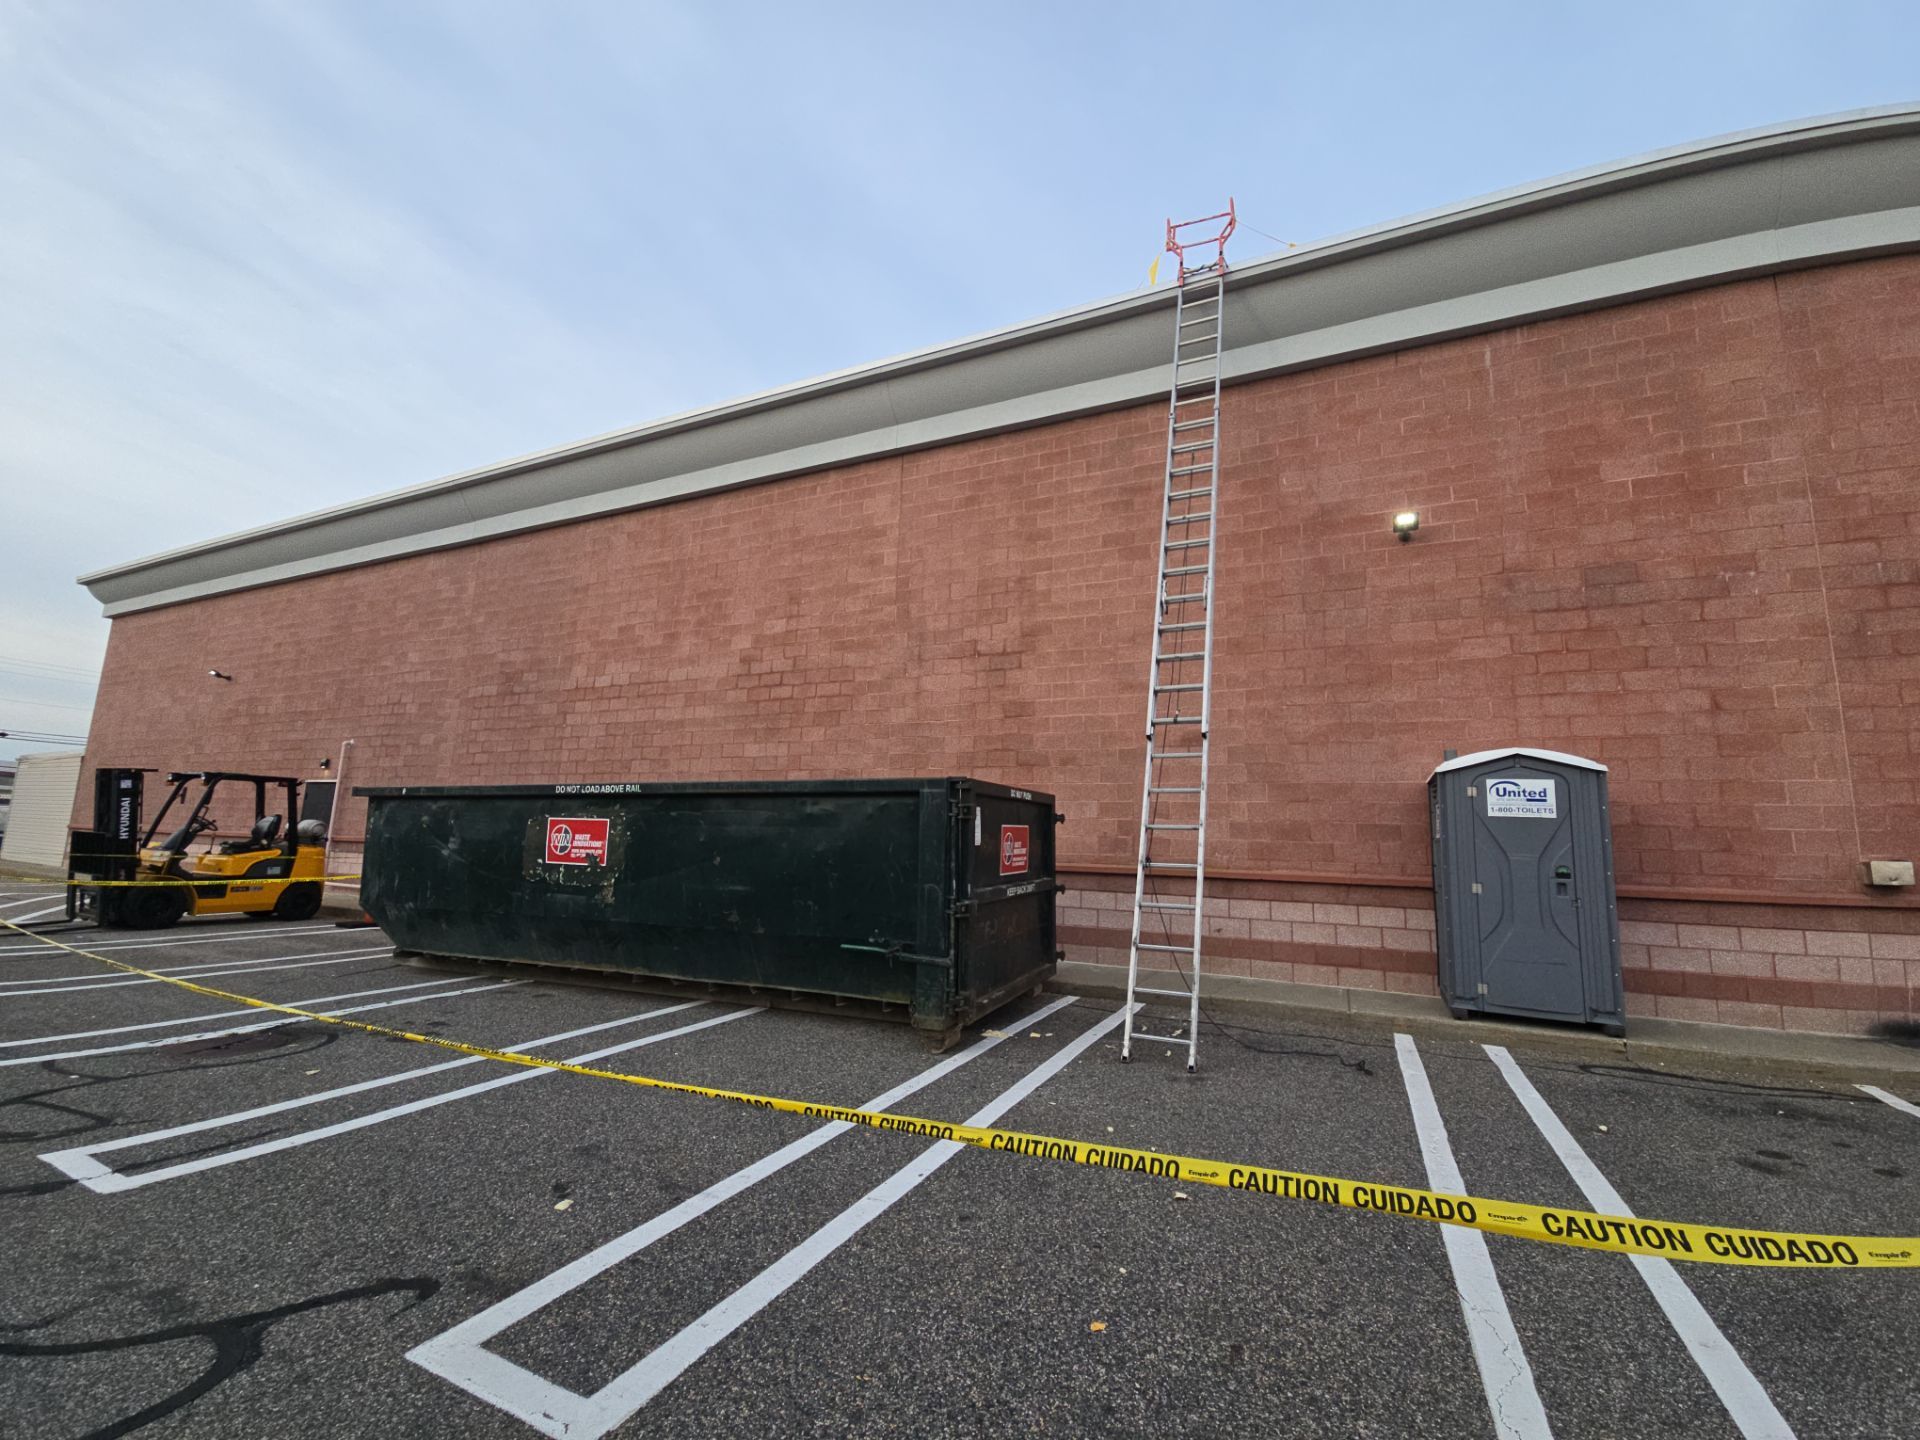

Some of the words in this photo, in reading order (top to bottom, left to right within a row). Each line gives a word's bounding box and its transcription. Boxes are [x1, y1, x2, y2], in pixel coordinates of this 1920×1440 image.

[555, 785, 566, 793] DO
[567, 785, 580, 794] NOT
[581, 785, 600, 794] LOAD
[600, 785, 625, 793] ABOVE
[625, 784, 642, 793] RAIL
[1496, 786, 1548, 798] United
[119, 797, 131, 839] HYUNDAI
[1490, 806, 1555, 815] 1-800-TOILETS
[990, 1133, 1077, 1162] CAUTION
[1086, 1148, 1180, 1179] CUIDADO
[1229, 1168, 1340, 1204] CAUTION
[1353, 1186, 1477, 1223] CUIDADO
[1541, 1212, 1693, 1253] CAUTION
[1704, 1232, 1859, 1266] CUIDADO
